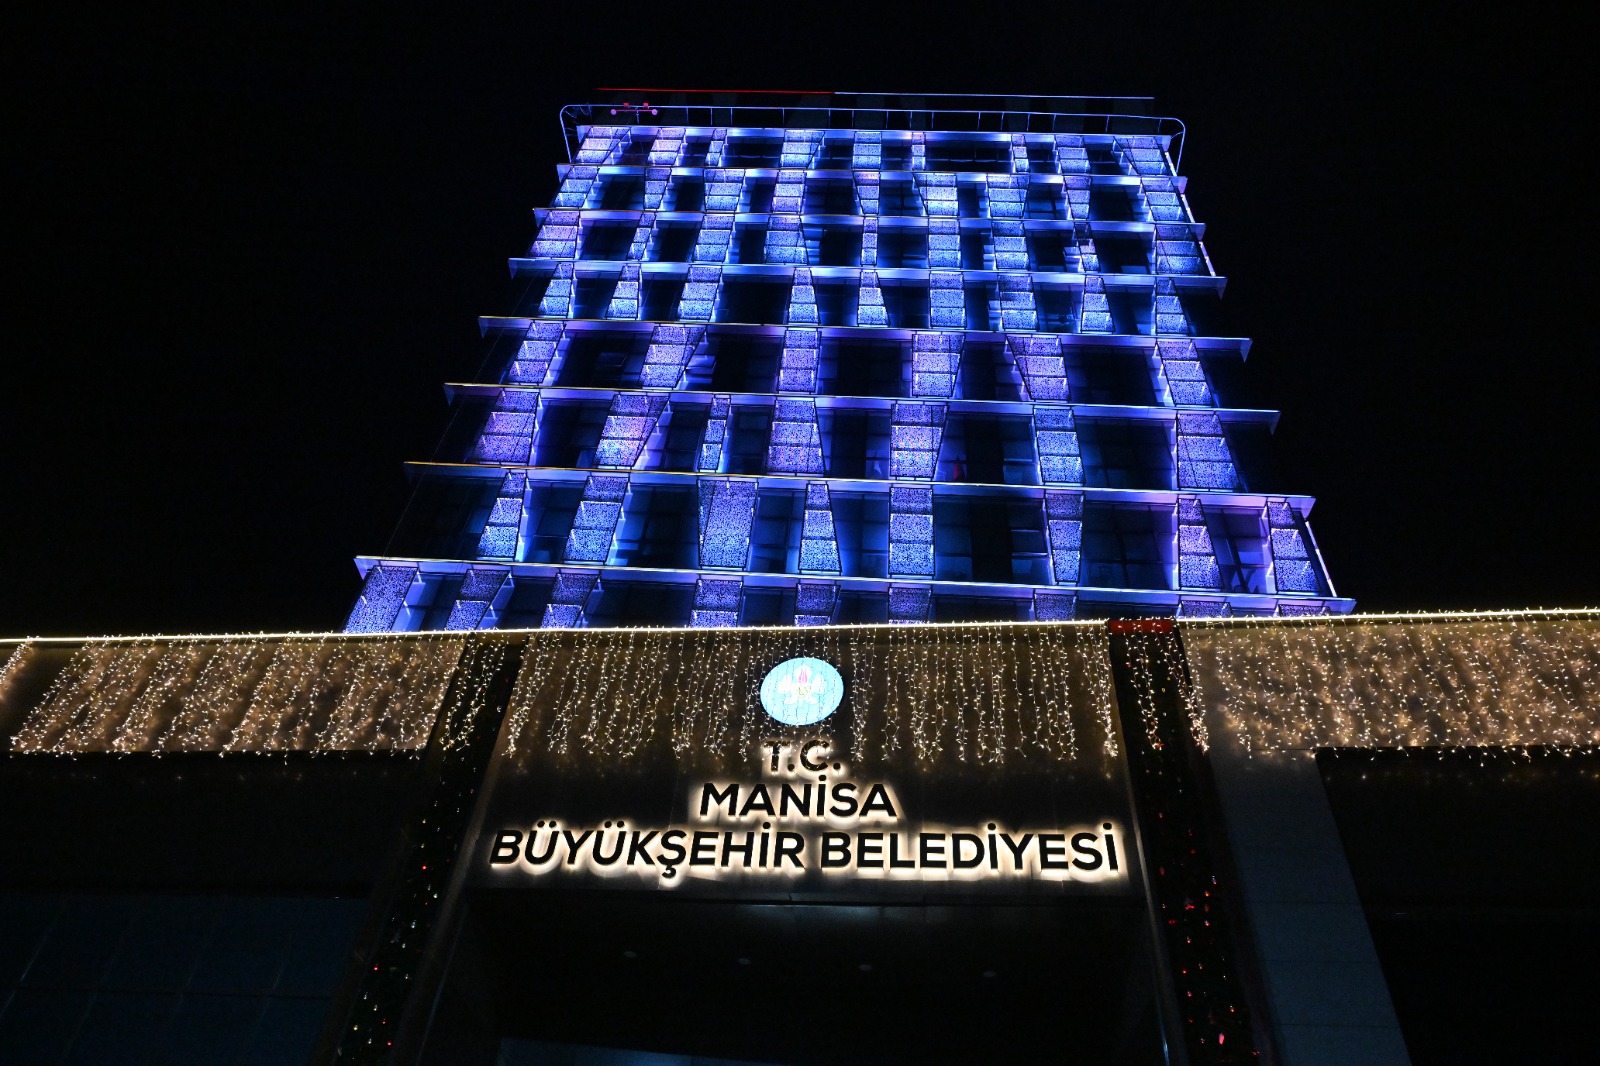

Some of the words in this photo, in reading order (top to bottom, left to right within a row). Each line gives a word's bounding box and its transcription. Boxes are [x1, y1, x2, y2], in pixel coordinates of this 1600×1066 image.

[763, 739, 841, 773] T.C.
[701, 775, 897, 818] MANİSA
[490, 821, 804, 878] BÜYÜKŞEHİR
[821, 823, 1119, 870] BELEDİYESİ
